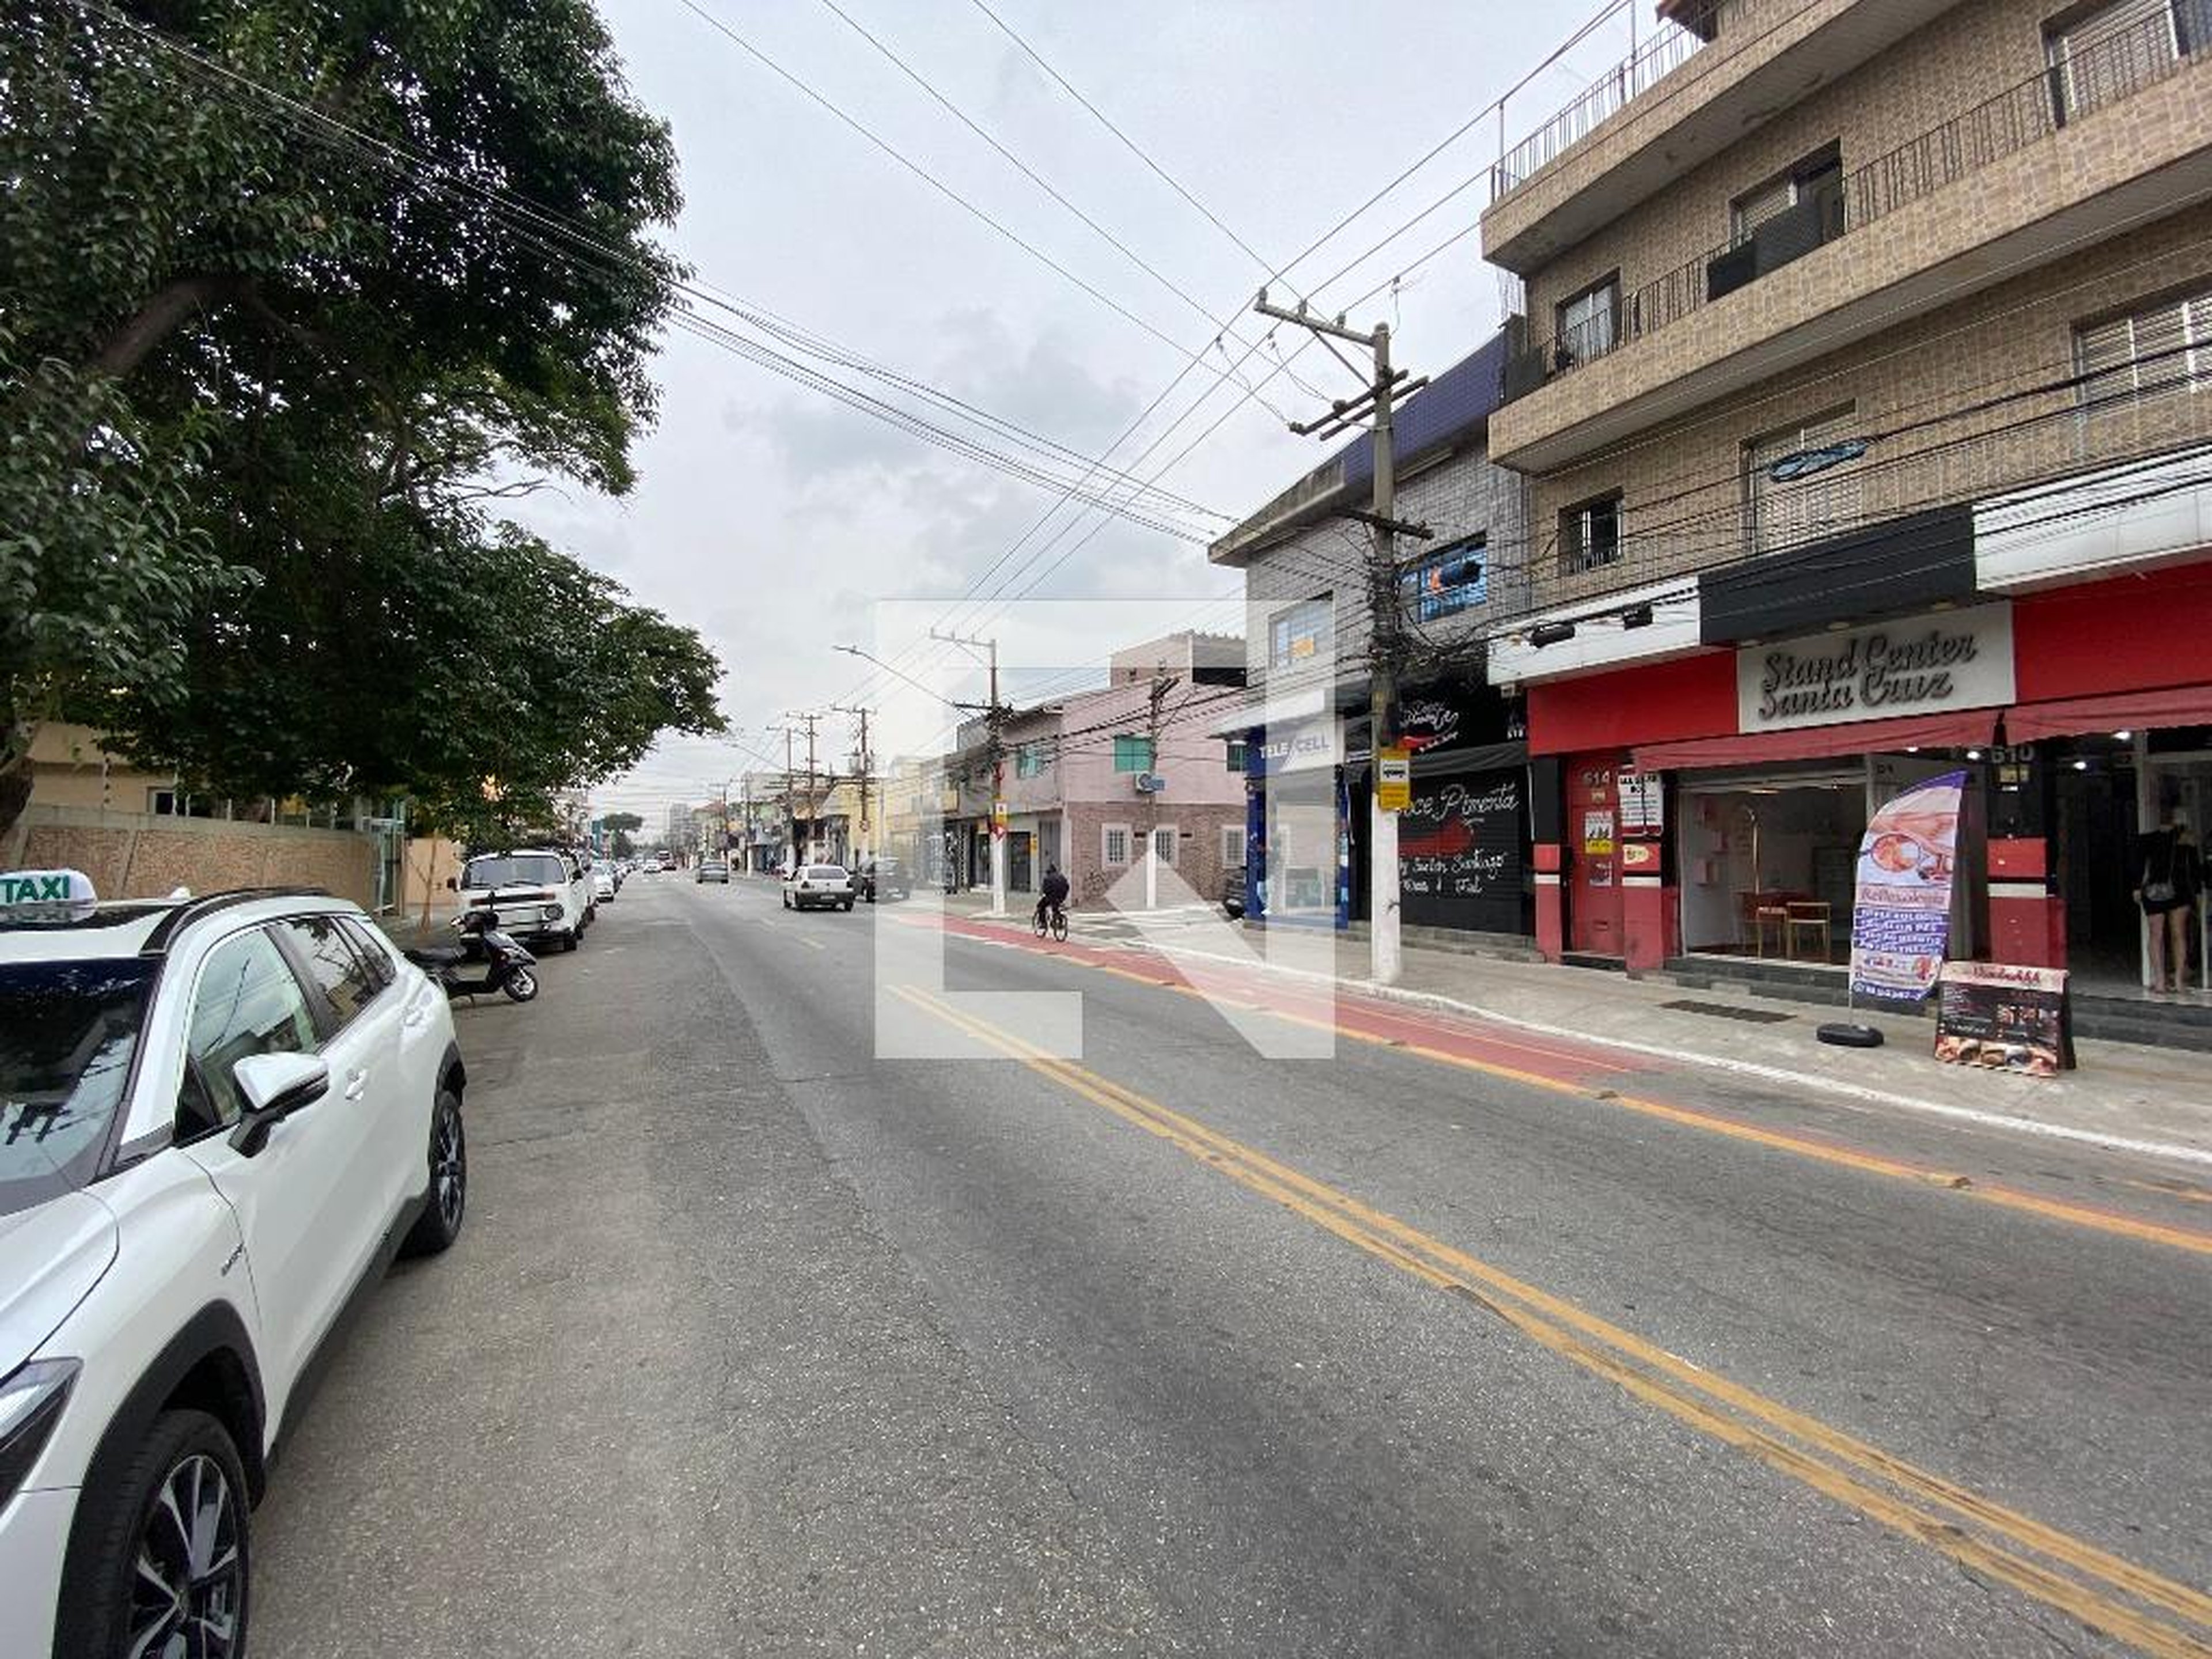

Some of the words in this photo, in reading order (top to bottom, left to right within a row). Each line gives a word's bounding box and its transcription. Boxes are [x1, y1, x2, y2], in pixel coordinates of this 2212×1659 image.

[1762, 638, 1858, 692] Stand
[1863, 631, 1978, 672] Center
[1758, 680, 1854, 721] Santa
[1859, 666, 1953, 707] Cruz
[0, 874, 70, 903] TAXI
